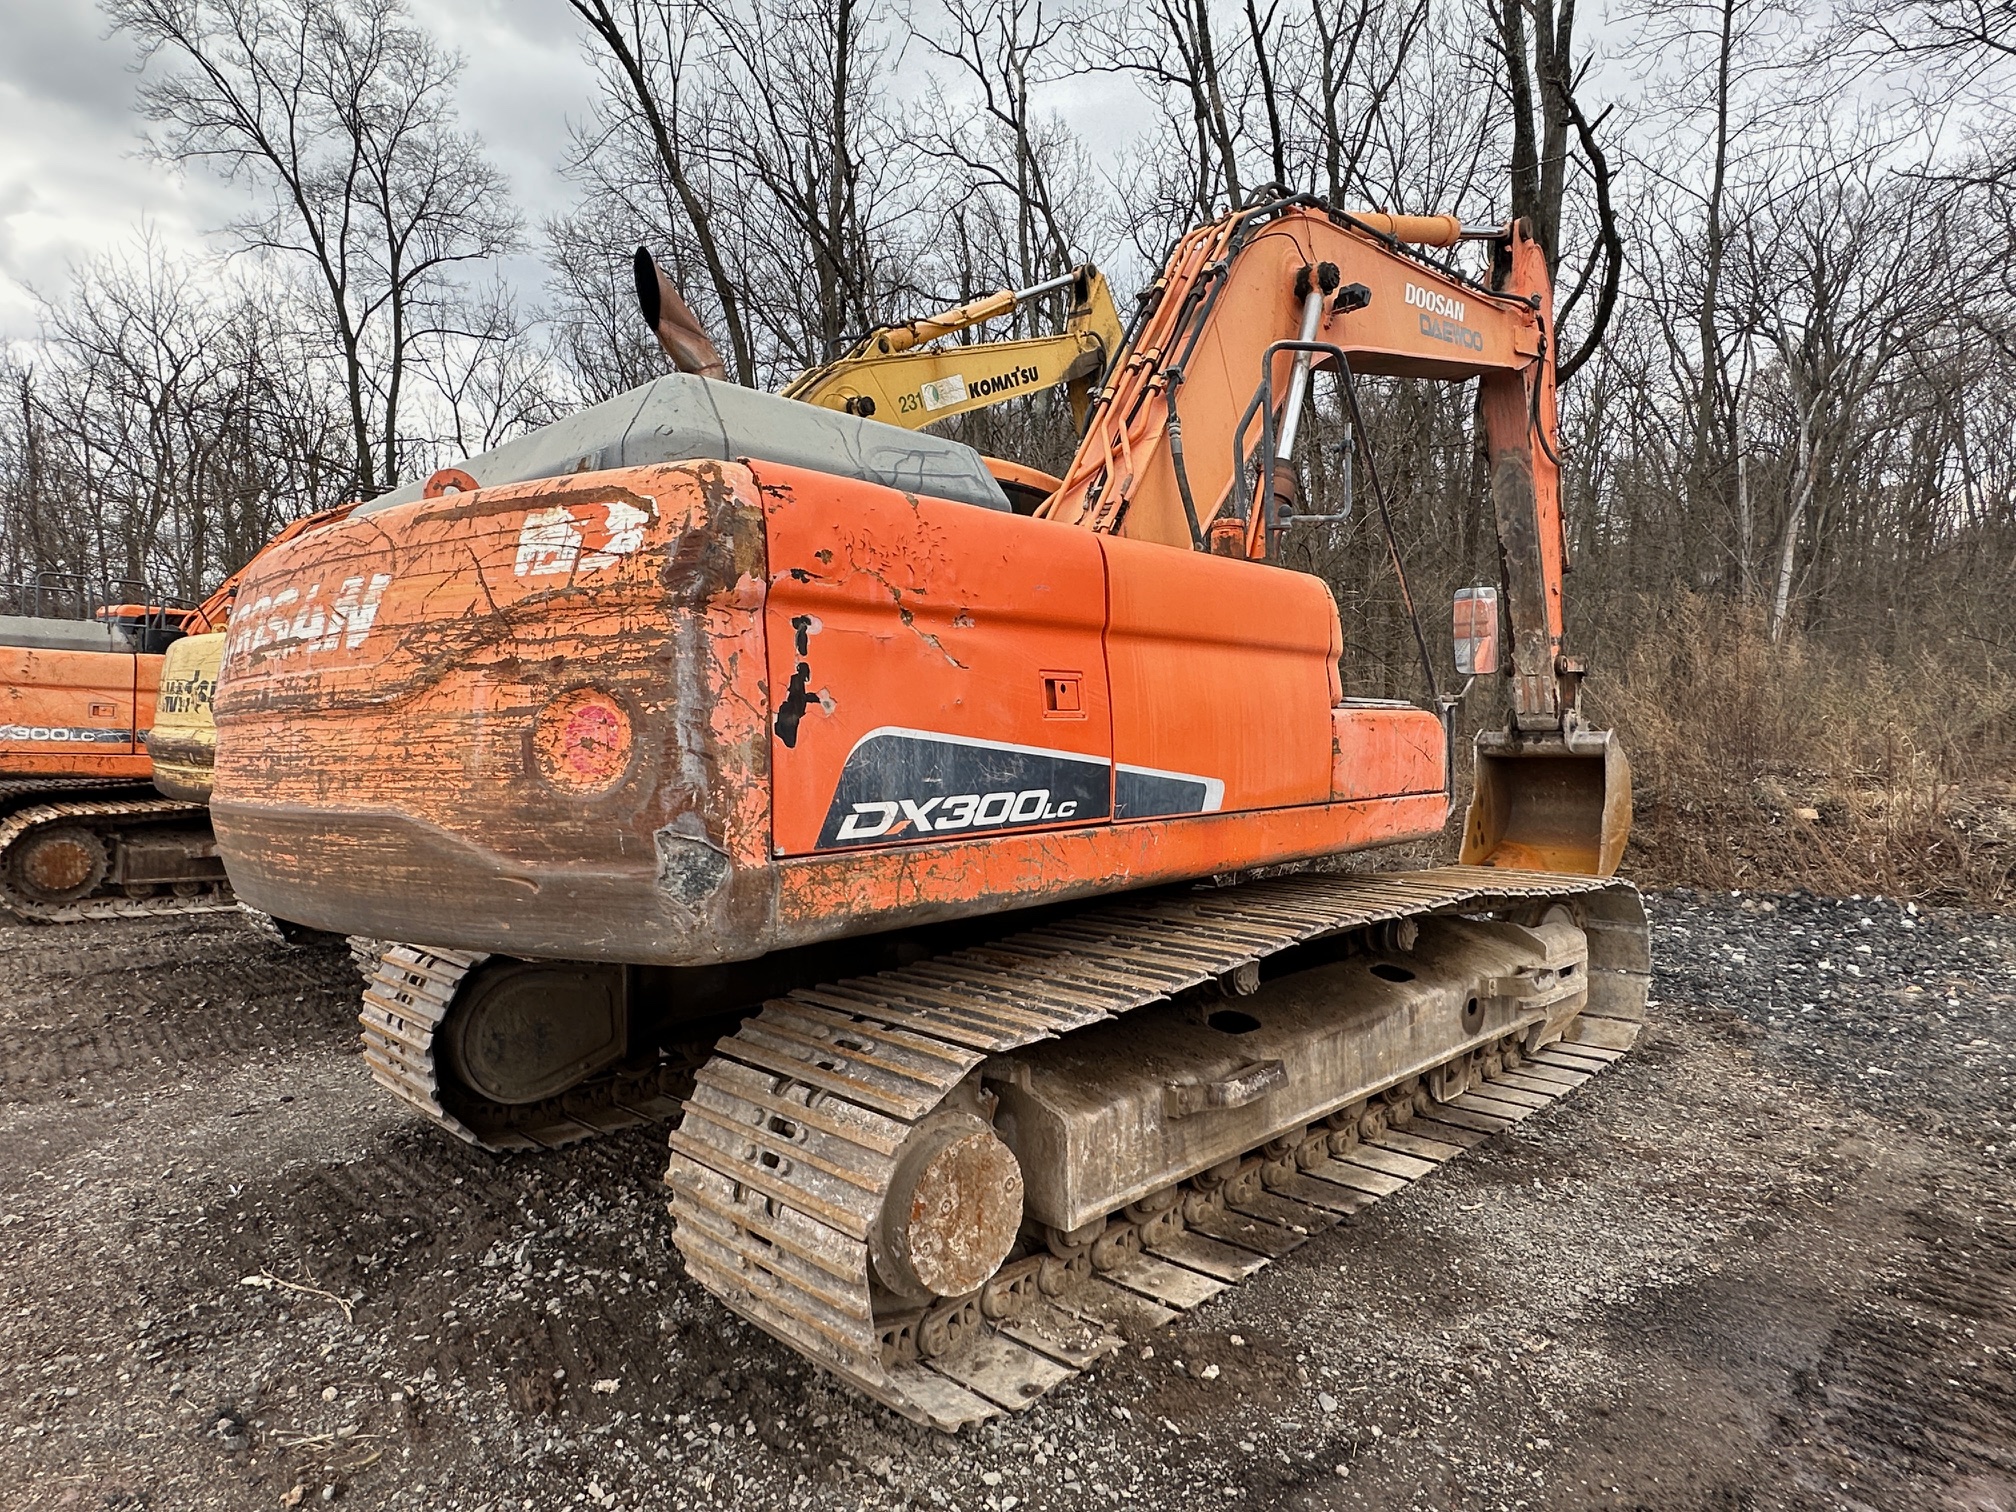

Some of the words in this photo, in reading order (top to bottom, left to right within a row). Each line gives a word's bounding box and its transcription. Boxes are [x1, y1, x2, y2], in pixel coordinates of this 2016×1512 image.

[1405, 282, 1465, 322] DOOSAN
[1420, 314, 1483, 351] DAEWOO
[968, 366, 1039, 399] KOMATSU
[898, 392, 924, 413] 231
[835, 789, 1077, 840] DX300LC
